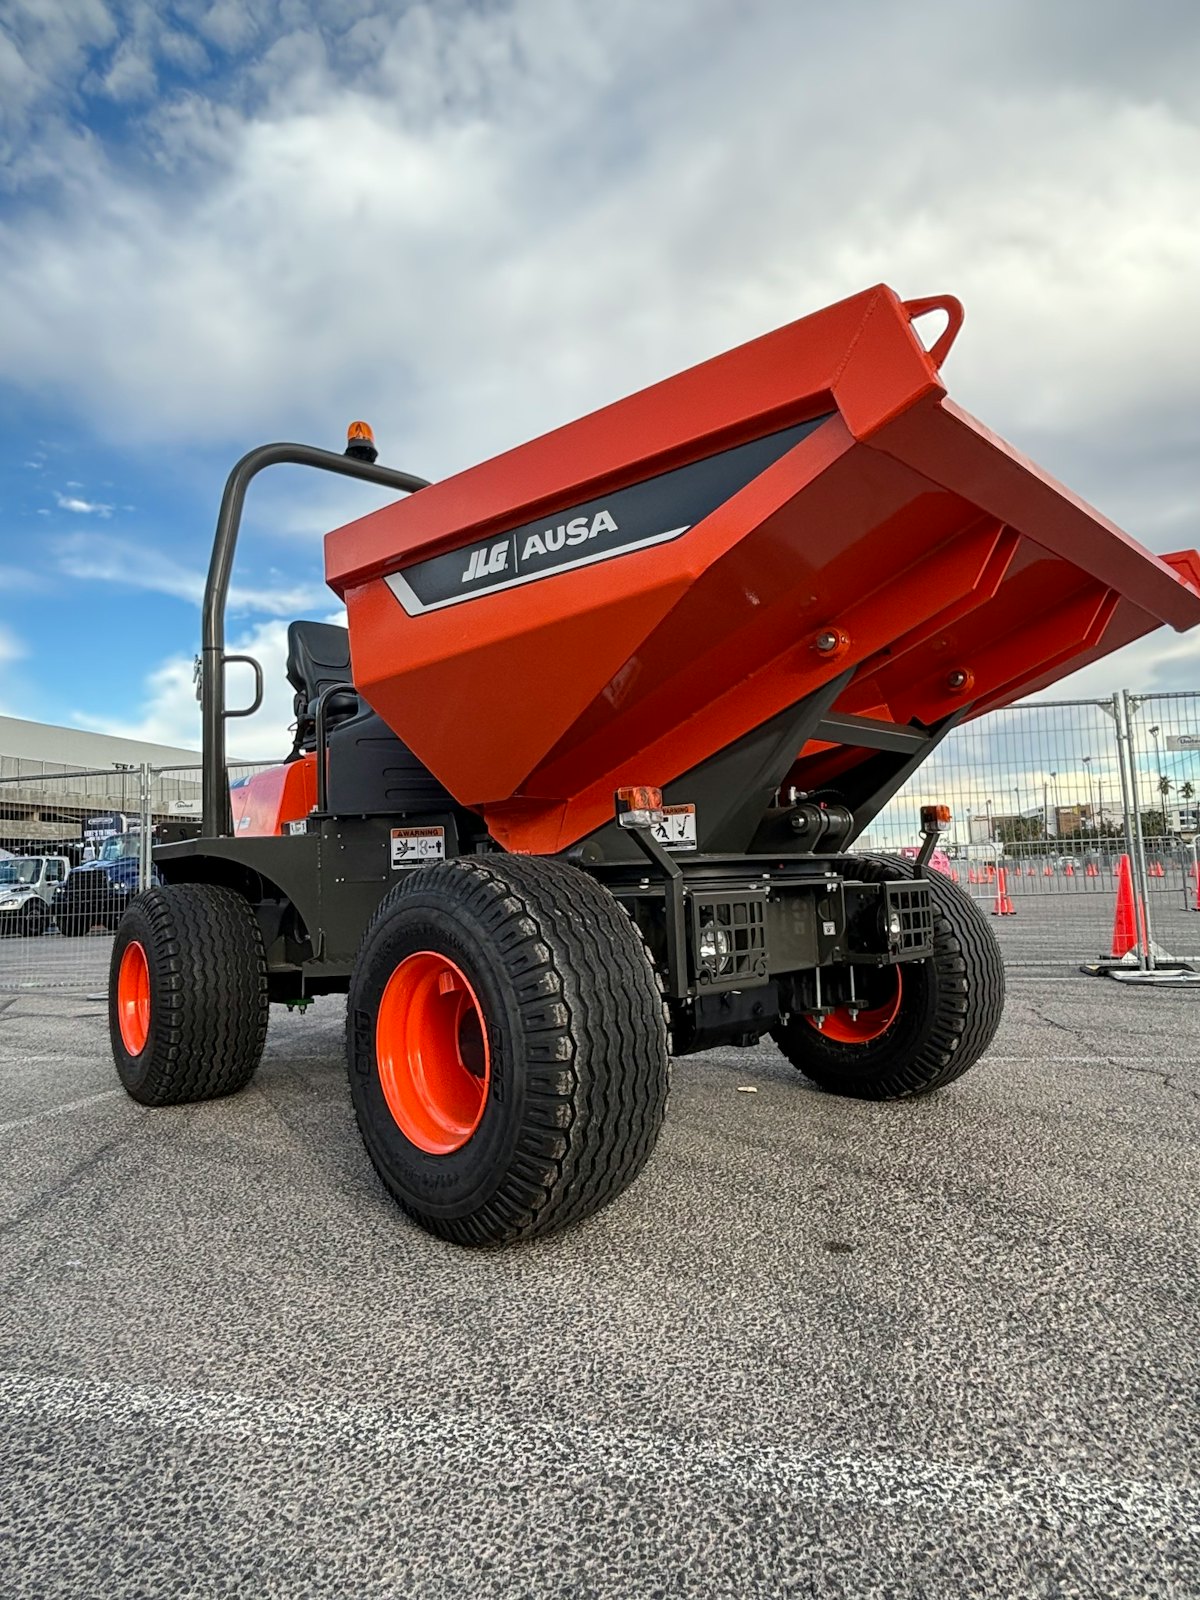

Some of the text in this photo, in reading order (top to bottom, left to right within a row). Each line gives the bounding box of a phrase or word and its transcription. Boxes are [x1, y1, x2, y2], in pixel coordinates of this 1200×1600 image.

[462, 509, 619, 583] JLG AUSA
[403, 828, 438, 837] WARNING
